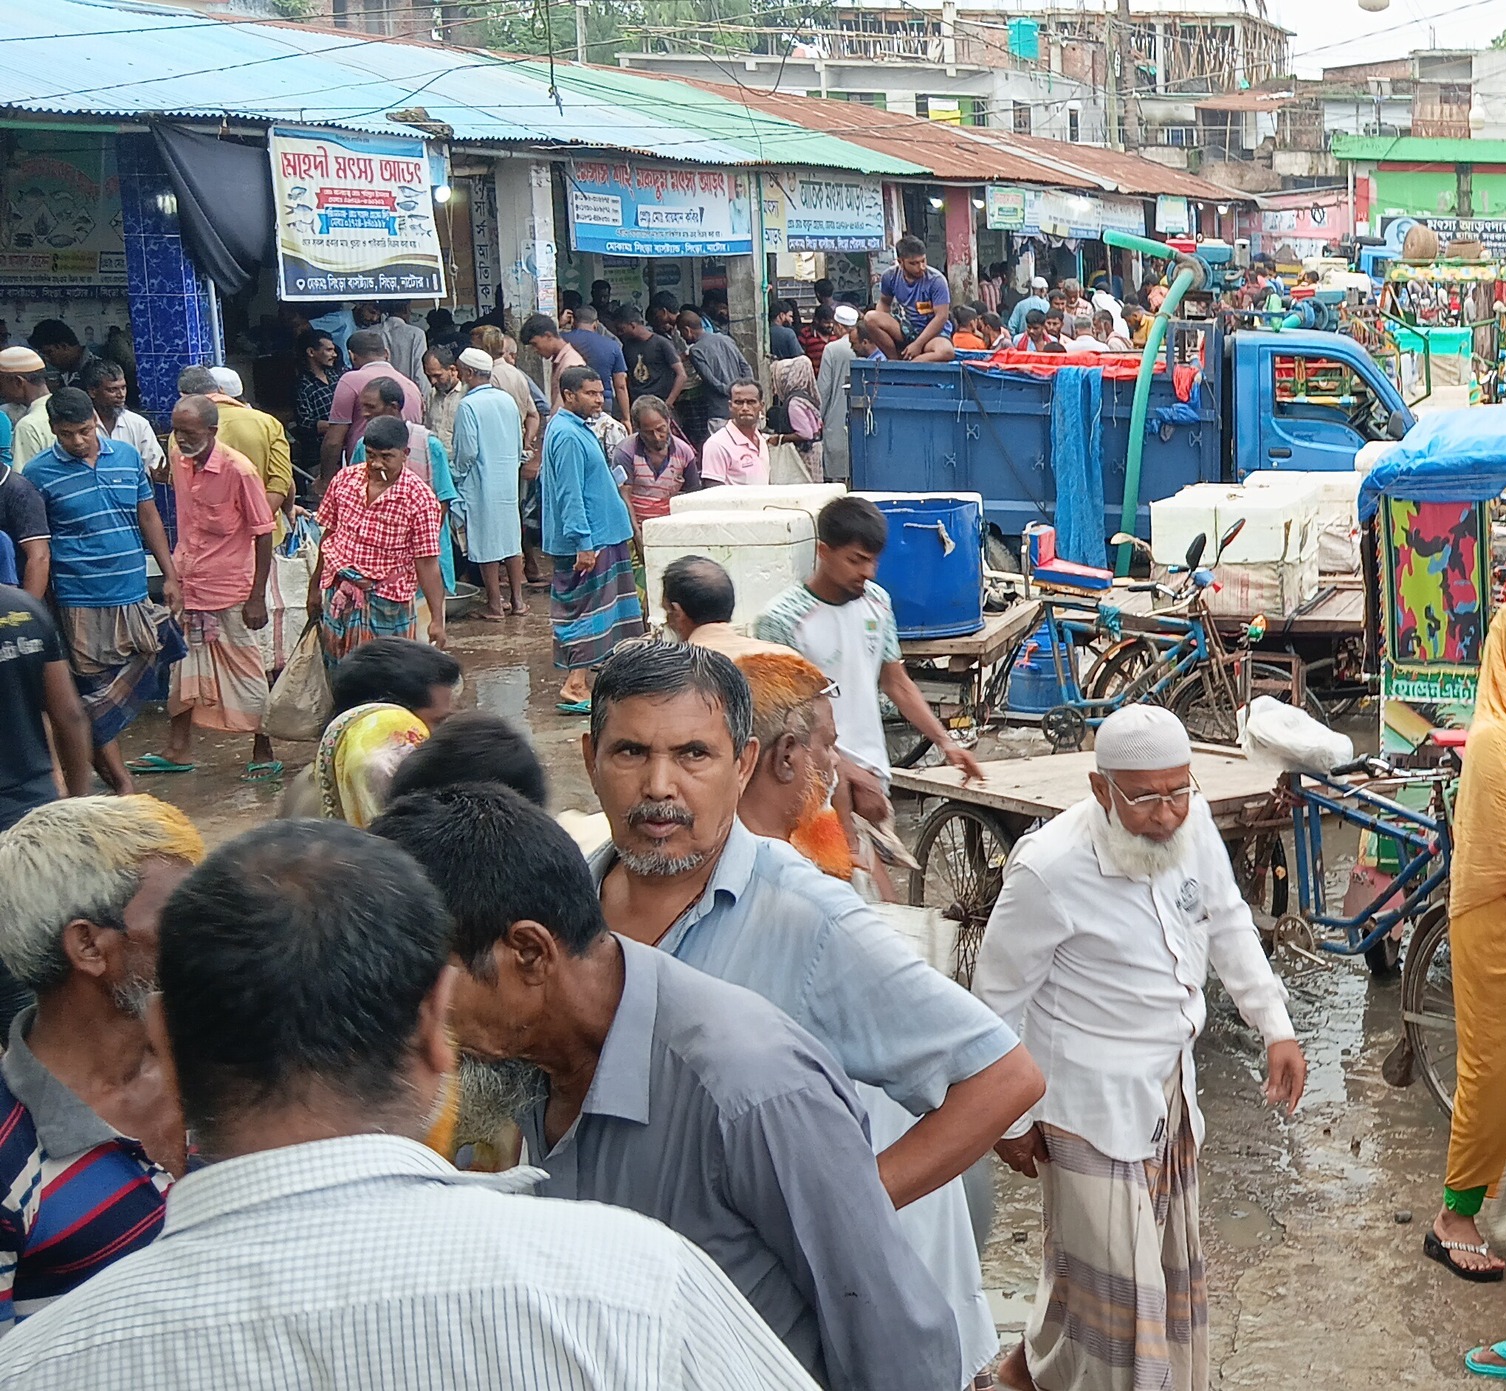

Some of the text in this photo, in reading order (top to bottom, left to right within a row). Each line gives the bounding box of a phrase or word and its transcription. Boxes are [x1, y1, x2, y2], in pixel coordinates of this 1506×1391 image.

[335, 156, 374, 184] মৎস্য
[669, 170, 696, 197] মৎস্য
[697, 171, 726, 198] আড়ৎ
[824, 182, 844, 211] মৎস্য
[844, 184, 865, 216] আড়ৎ
[1392, 676, 1475, 702] হোসেন এন্টা
